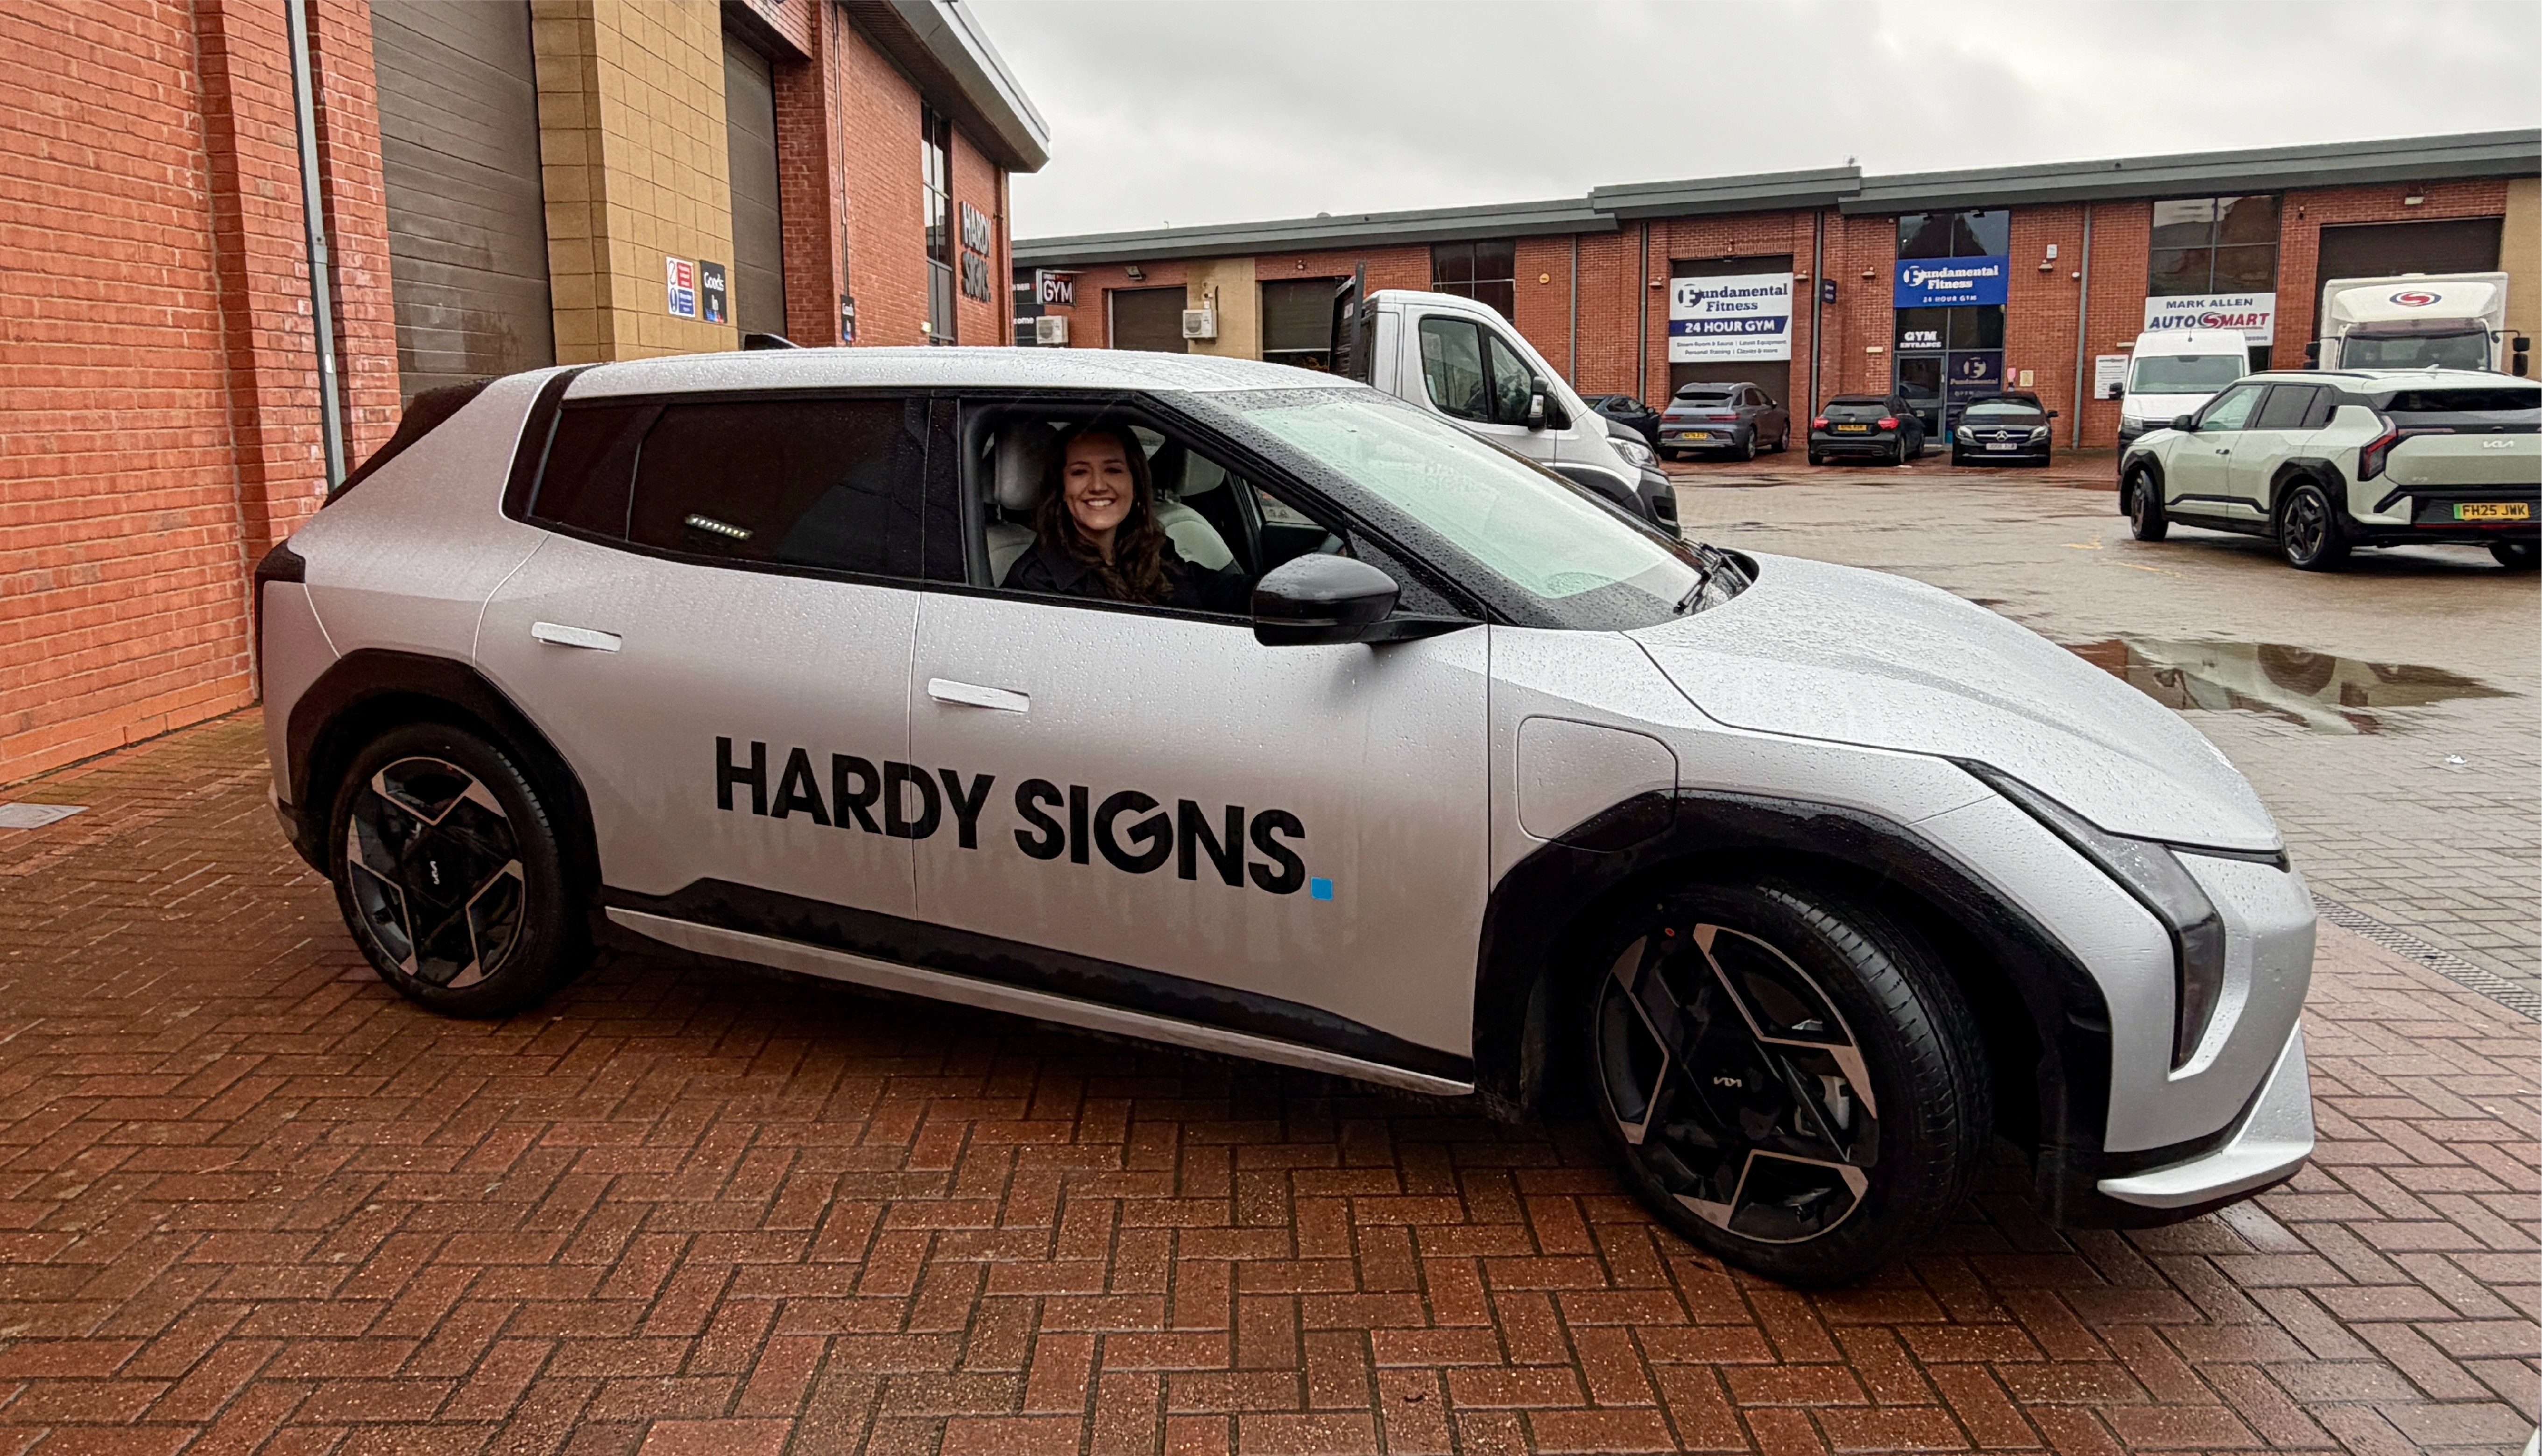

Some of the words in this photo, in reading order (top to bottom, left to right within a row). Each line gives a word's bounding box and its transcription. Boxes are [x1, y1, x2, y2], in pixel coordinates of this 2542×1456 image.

[704, 272, 725, 291] Goods
[1927, 279, 1973, 289] Fitness
[1044, 280, 1073, 302] GYM
[1678, 283, 1788, 308] Fundamental
[1706, 301, 1758, 312] Fitness
[2166, 299, 2205, 309] MARK
[2209, 298, 2253, 307] ALLEN
[1685, 322, 1701, 334] 24
[1704, 320, 1743, 333] HOUR
[1745, 319, 1775, 332] GYM
[2149, 312, 2271, 329] AUTOSMART
[1904, 331, 1938, 341] GYM
[2462, 504, 2497, 516] FH25
[2501, 504, 2526, 516] JWK
[716, 736, 996, 850] HARDY
